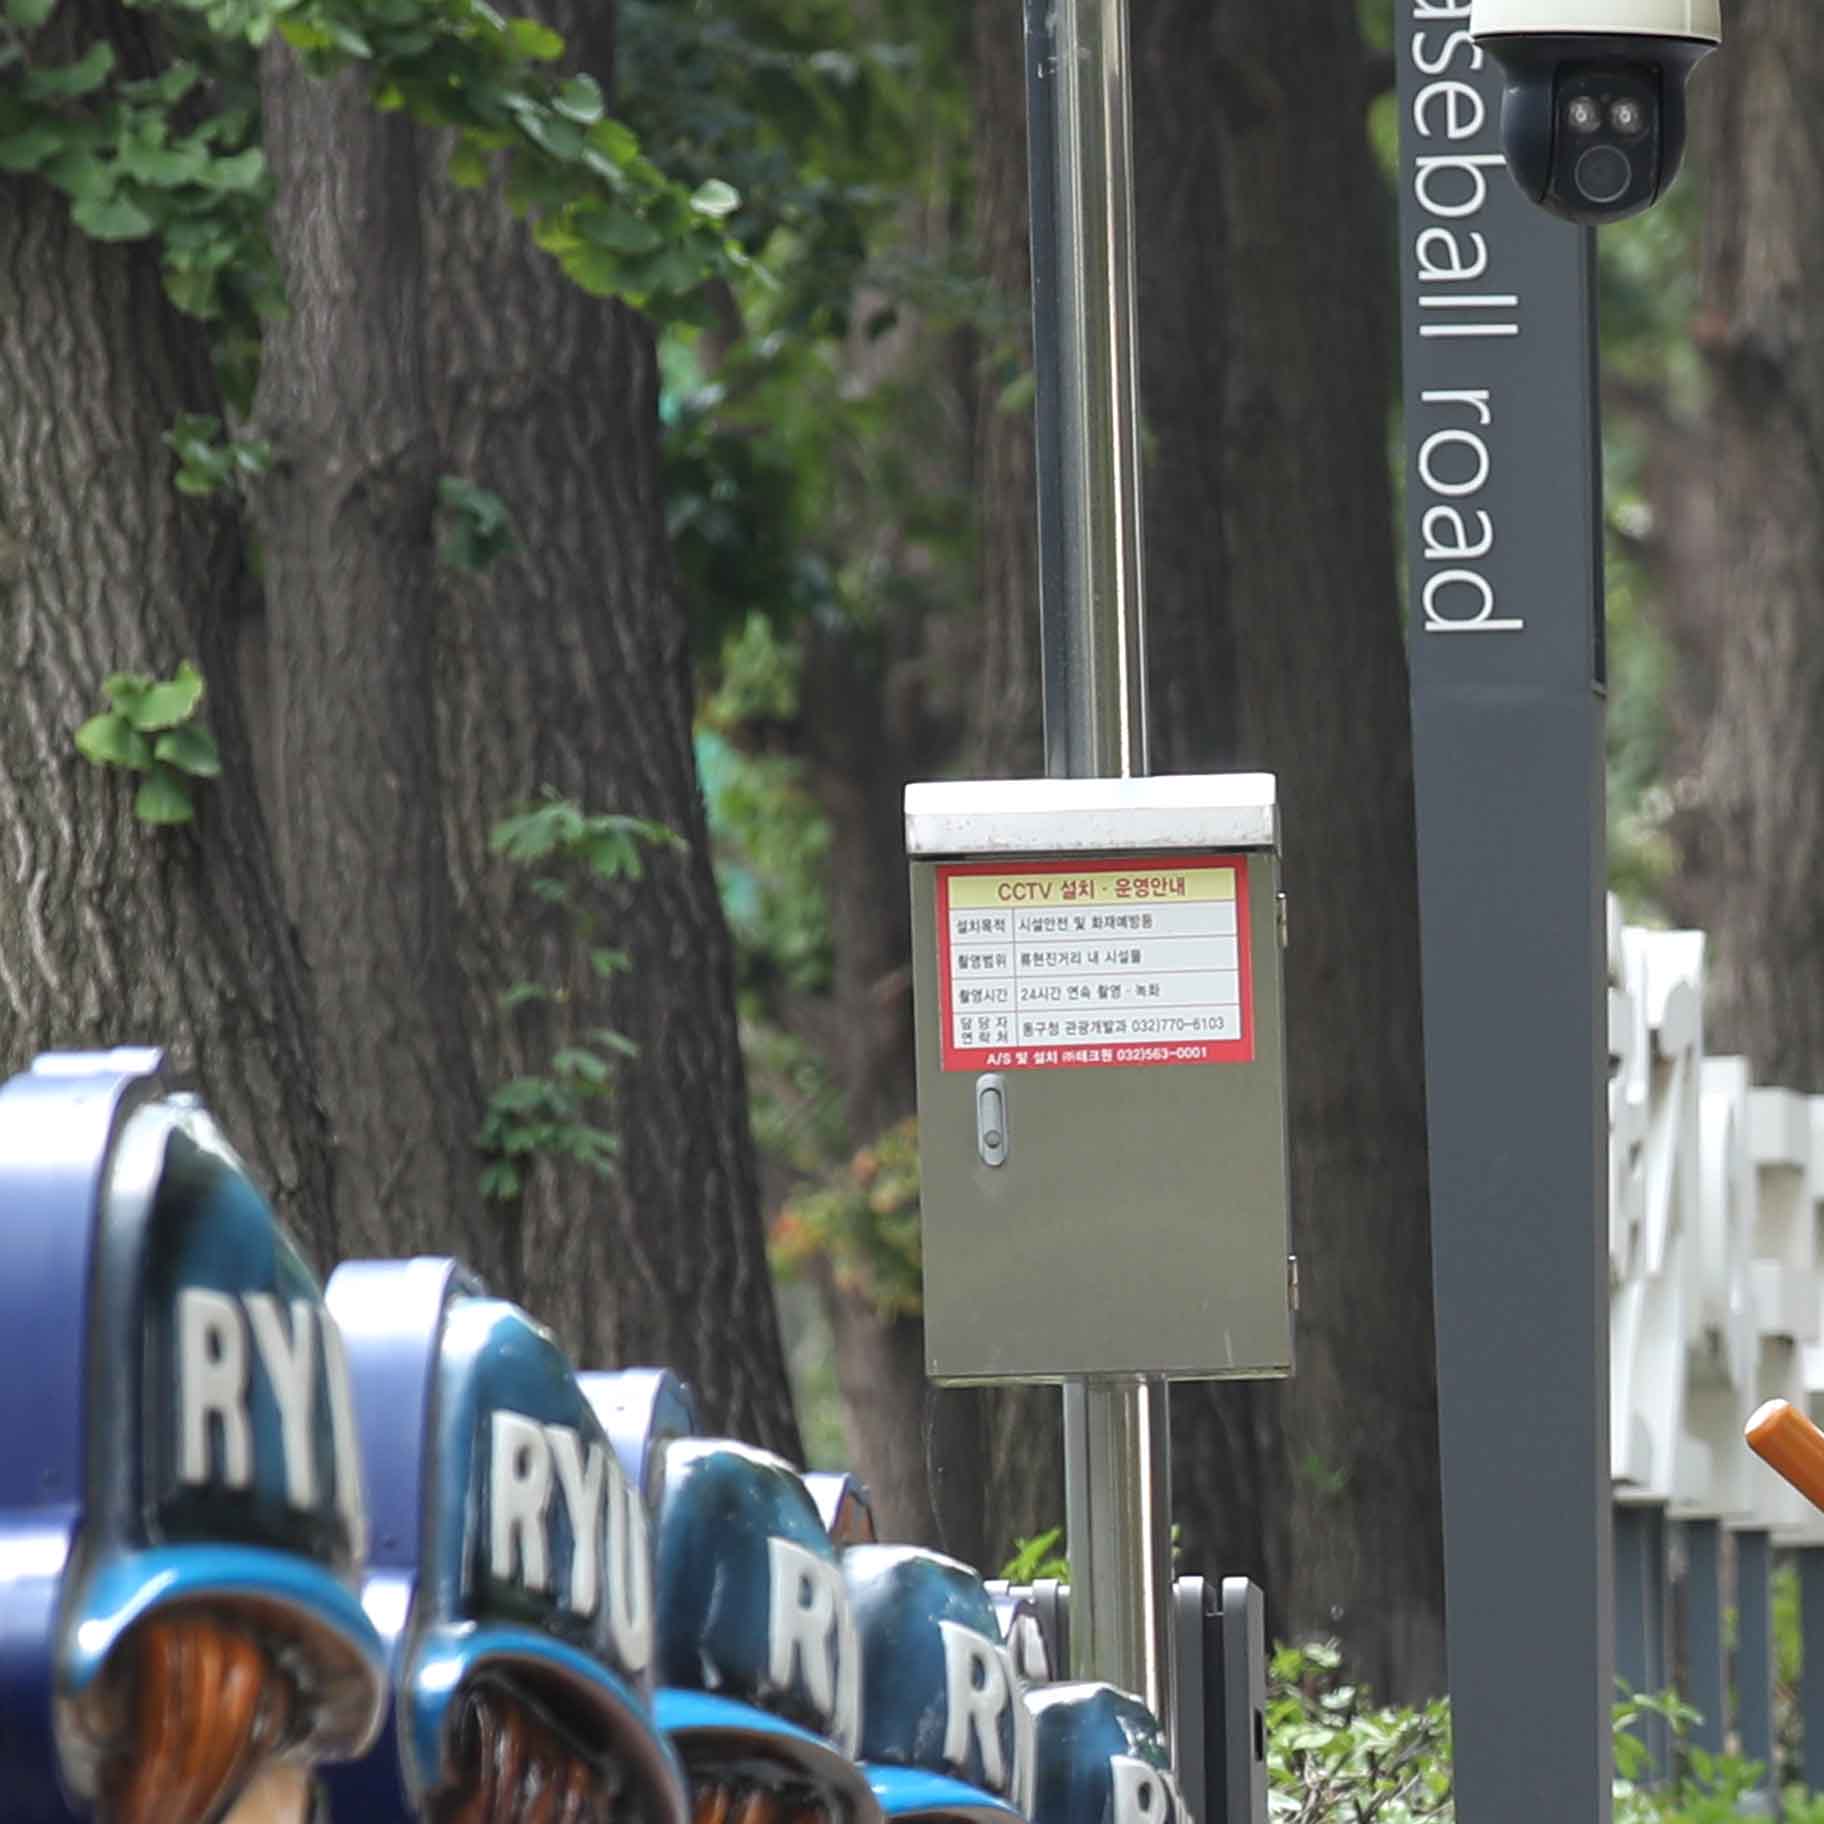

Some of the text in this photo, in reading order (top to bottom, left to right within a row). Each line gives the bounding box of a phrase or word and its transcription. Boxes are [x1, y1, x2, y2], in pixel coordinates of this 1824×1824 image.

[1418, 389, 1525, 632] road
[997, 876, 1186, 901] CCTV 설치 운영안내
[1019, 915, 1068, 932] 시설안전
[1021, 986, 1062, 1001] 24시간
[986, 1051, 1012, 1066] A/S
